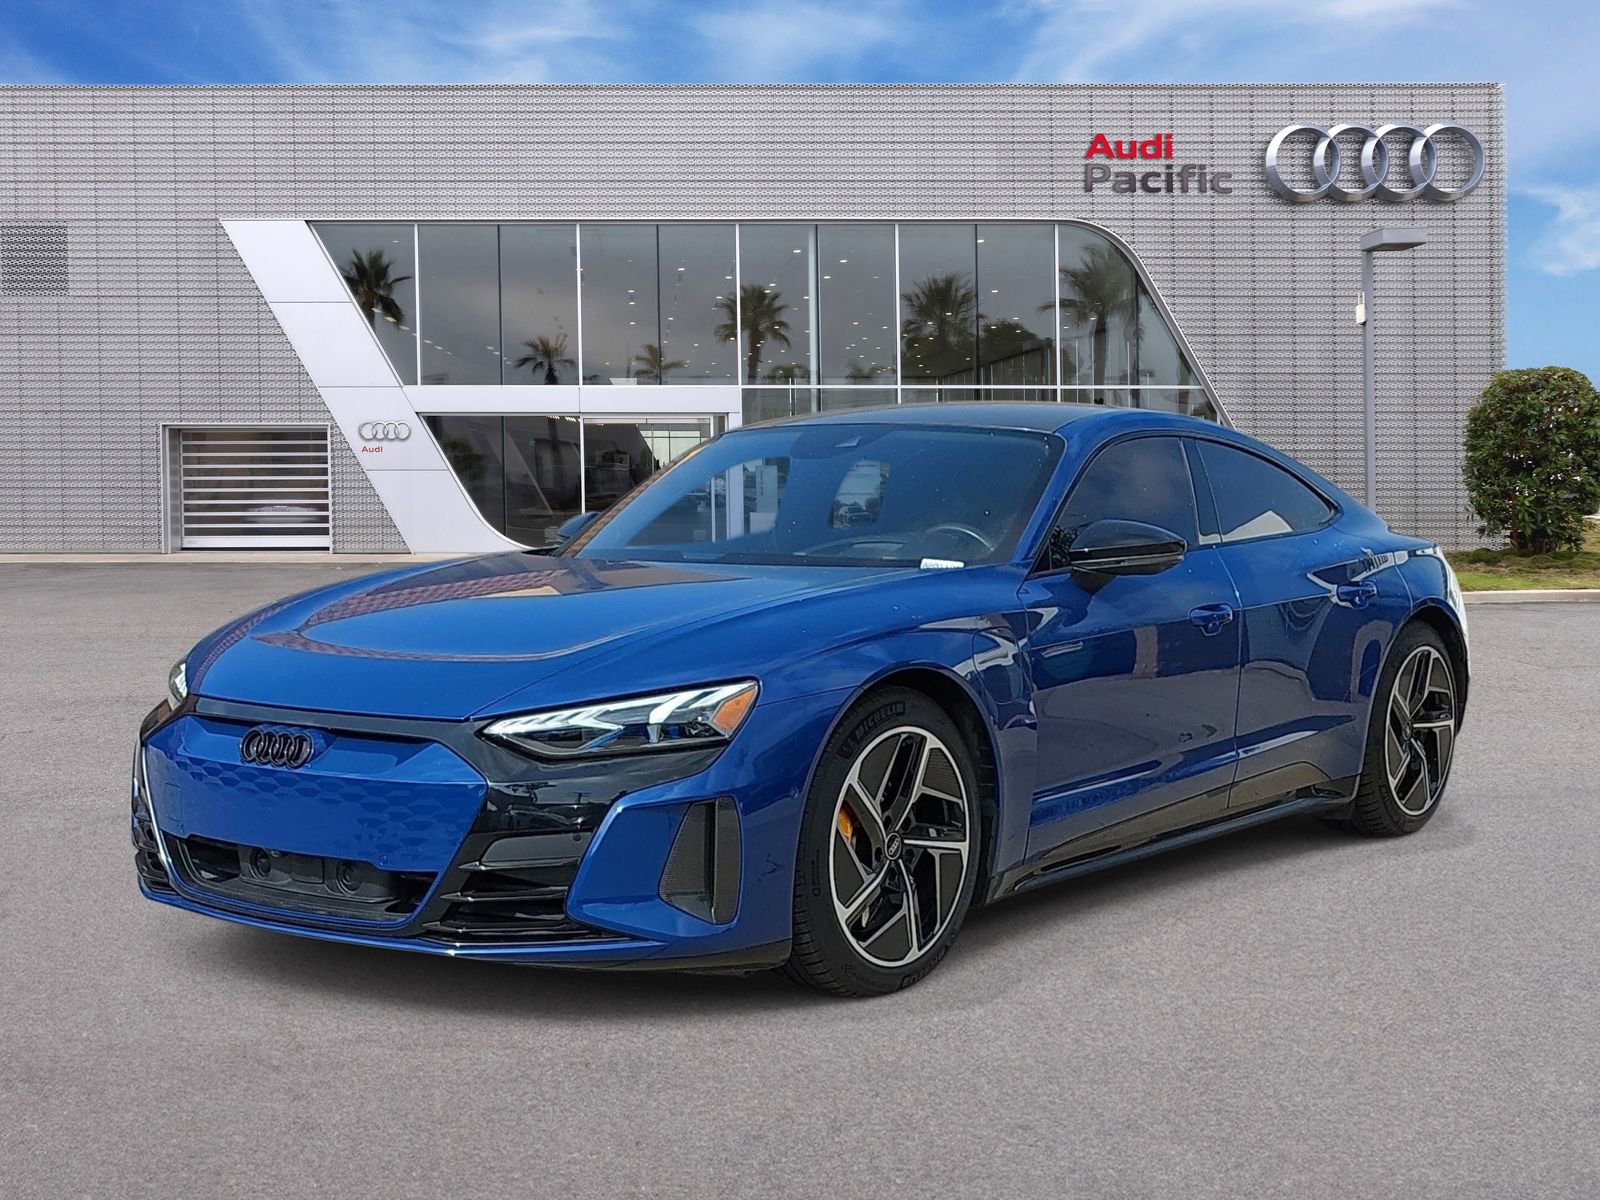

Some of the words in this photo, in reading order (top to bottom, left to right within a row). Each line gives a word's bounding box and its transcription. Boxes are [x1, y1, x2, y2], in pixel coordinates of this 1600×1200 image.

[1085, 133, 1173, 160] Audi
[1085, 163, 1233, 194] Pacific
[855, 703, 904, 740] MICHELIN
